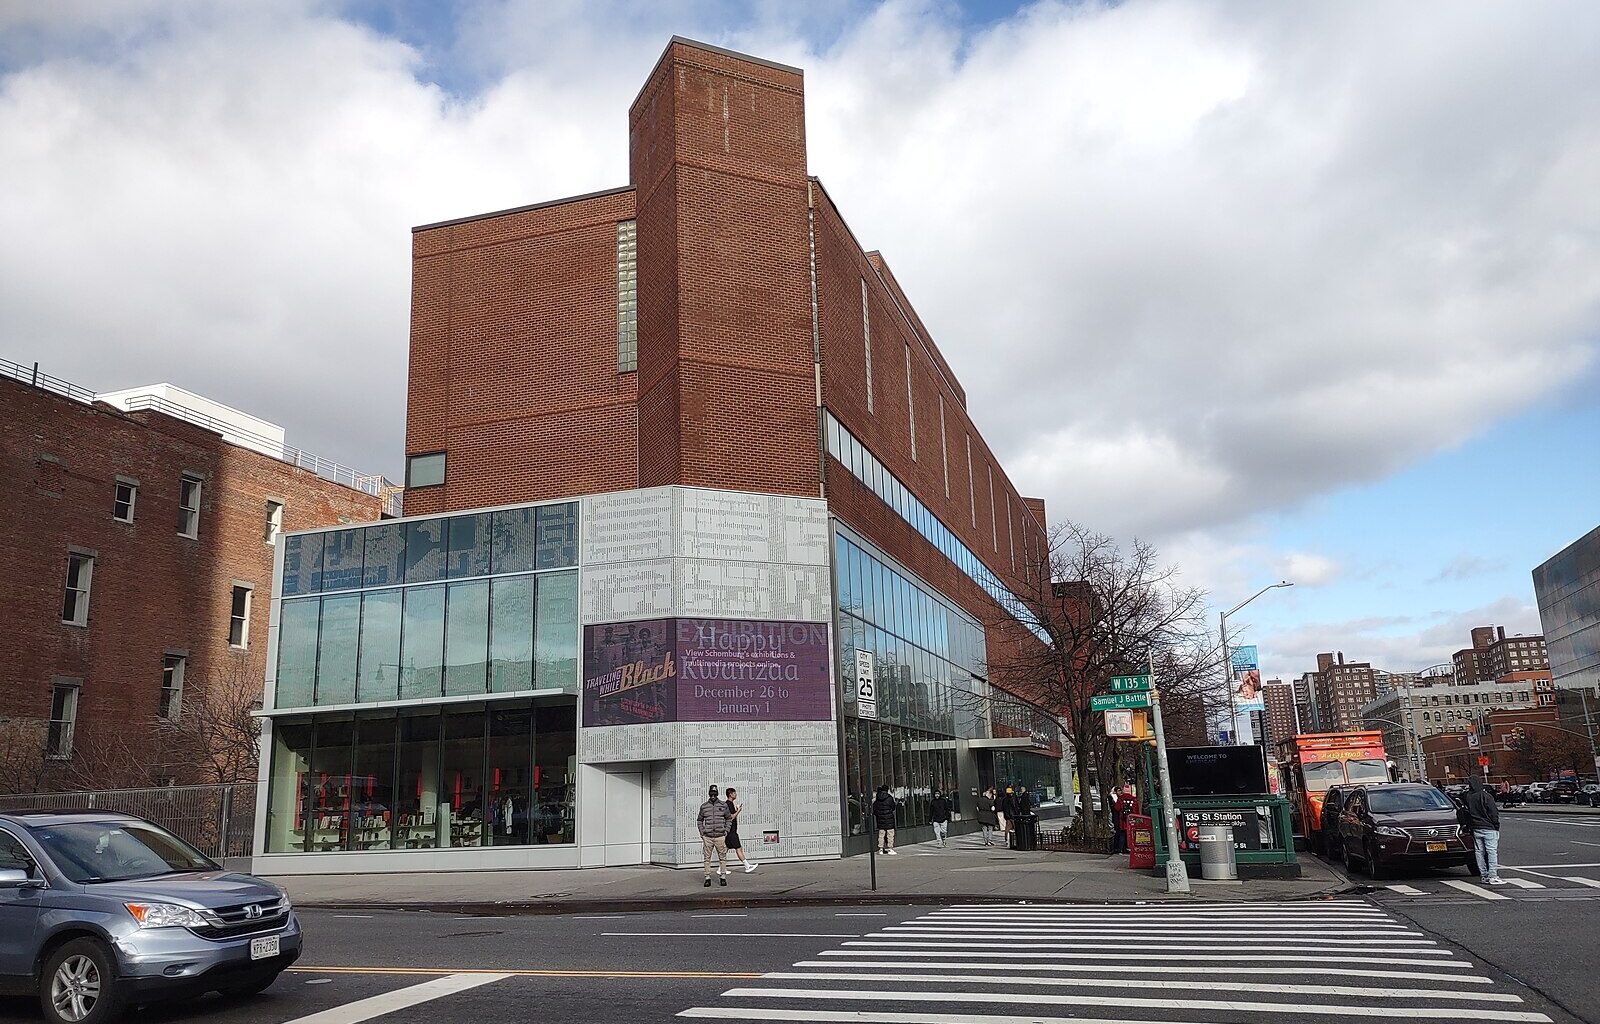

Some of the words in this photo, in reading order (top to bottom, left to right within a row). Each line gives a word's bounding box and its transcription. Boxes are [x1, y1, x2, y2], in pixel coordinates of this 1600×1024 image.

[676, 620, 828, 646] EXHIBITION
[697, 626, 783, 654] Happy
[685, 649, 704, 658] View
[705, 649, 750, 660] Schomburg's
[615, 651, 676, 691] Black
[681, 656, 800, 681] Kwanzaa
[859, 660, 870, 668] SPEED
[586, 670, 622, 690] TRAVELING
[599, 680, 620, 695] WHILE
[859, 677, 873, 697] 25
[1113, 678, 1121, 690] W
[1124, 677, 1139, 689] 135
[694, 685, 755, 699] December
[759, 685, 775, 699] 26
[778, 687, 789, 699] to
[1093, 697, 1118, 706] Samuel
[1119, 696, 1124, 704] J
[1125, 693, 1146, 703] Battle
[716, 701, 762, 717] January
[765, 701, 771, 713] 1
[702, 729, 772, 743] Schomburg
[774, 728, 815, 739] Center
[1185, 813, 1200, 821] 135
[1202, 812, 1212, 821] St
[1213, 812, 1243, 820] Station
[1191, 830, 1199, 839] 2
